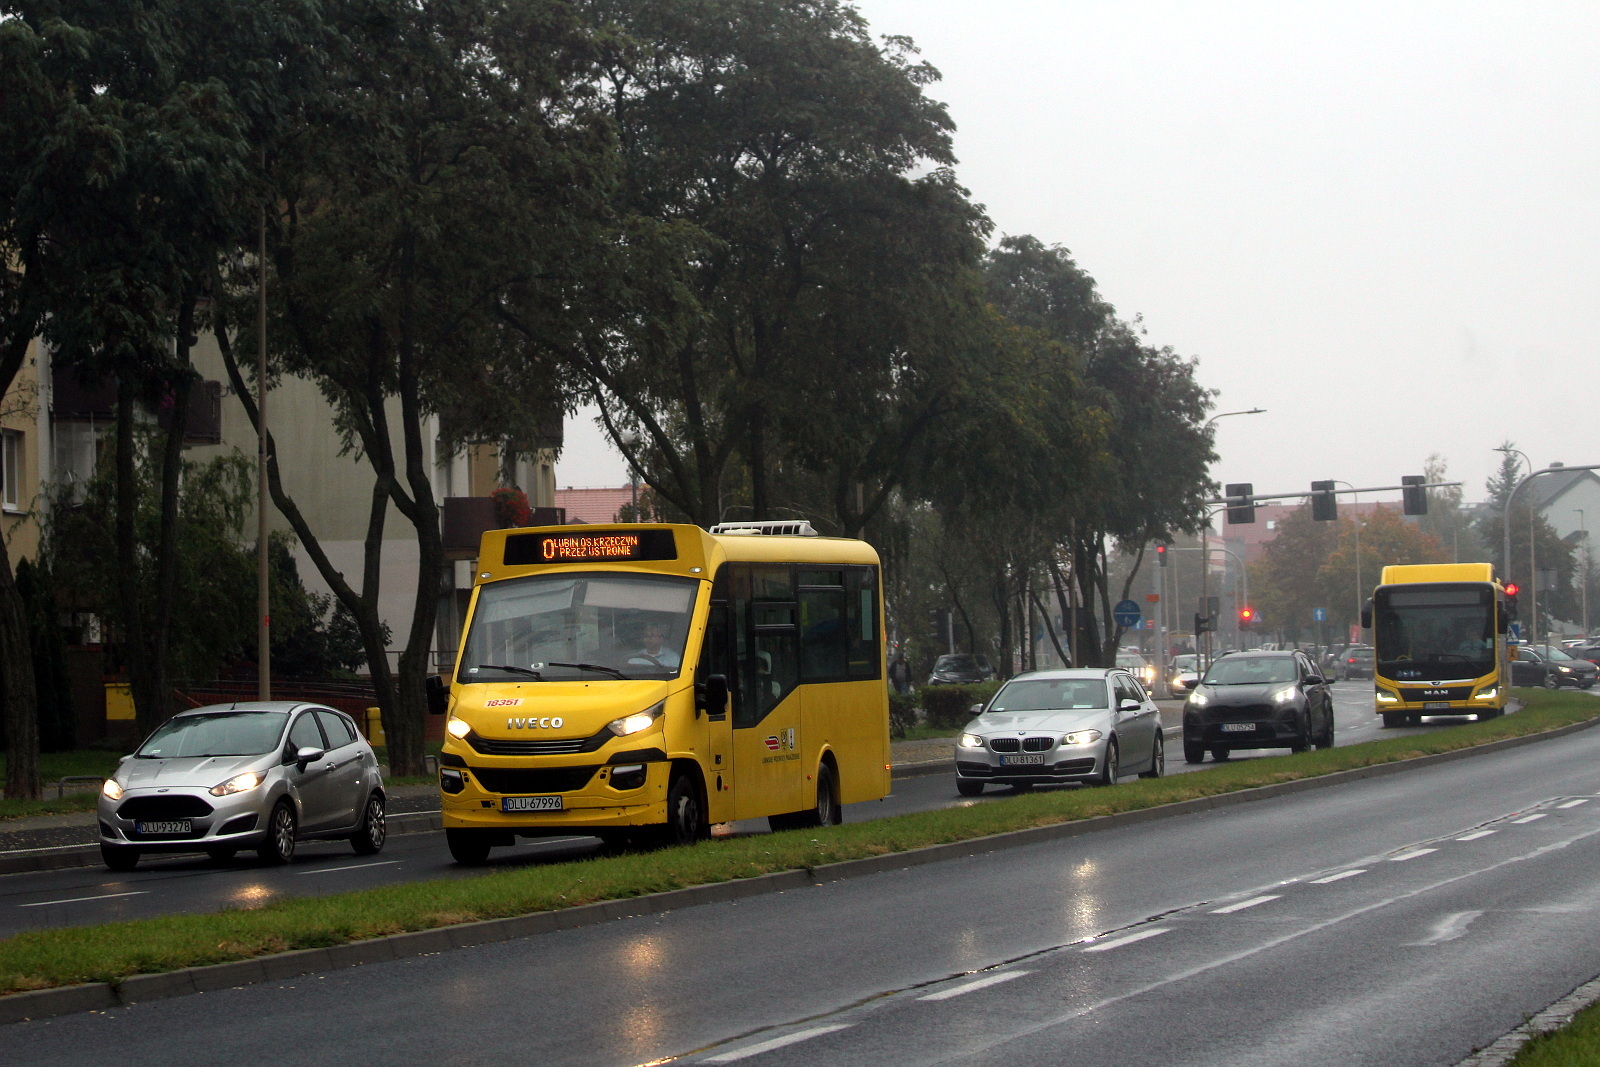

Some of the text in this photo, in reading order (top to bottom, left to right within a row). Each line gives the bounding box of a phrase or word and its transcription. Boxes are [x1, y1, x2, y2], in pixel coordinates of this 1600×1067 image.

[554, 538, 579, 548] LUBIN
[560, 545, 631, 557] PRZEZ USTRONIE
[487, 698, 520, 707] 18351
[507, 717, 564, 729] IVECO
[1004, 756, 1042, 764] DLU 81361
[508, 797, 561, 809] DLU 67996
[141, 821, 190, 833] DLU 93278
